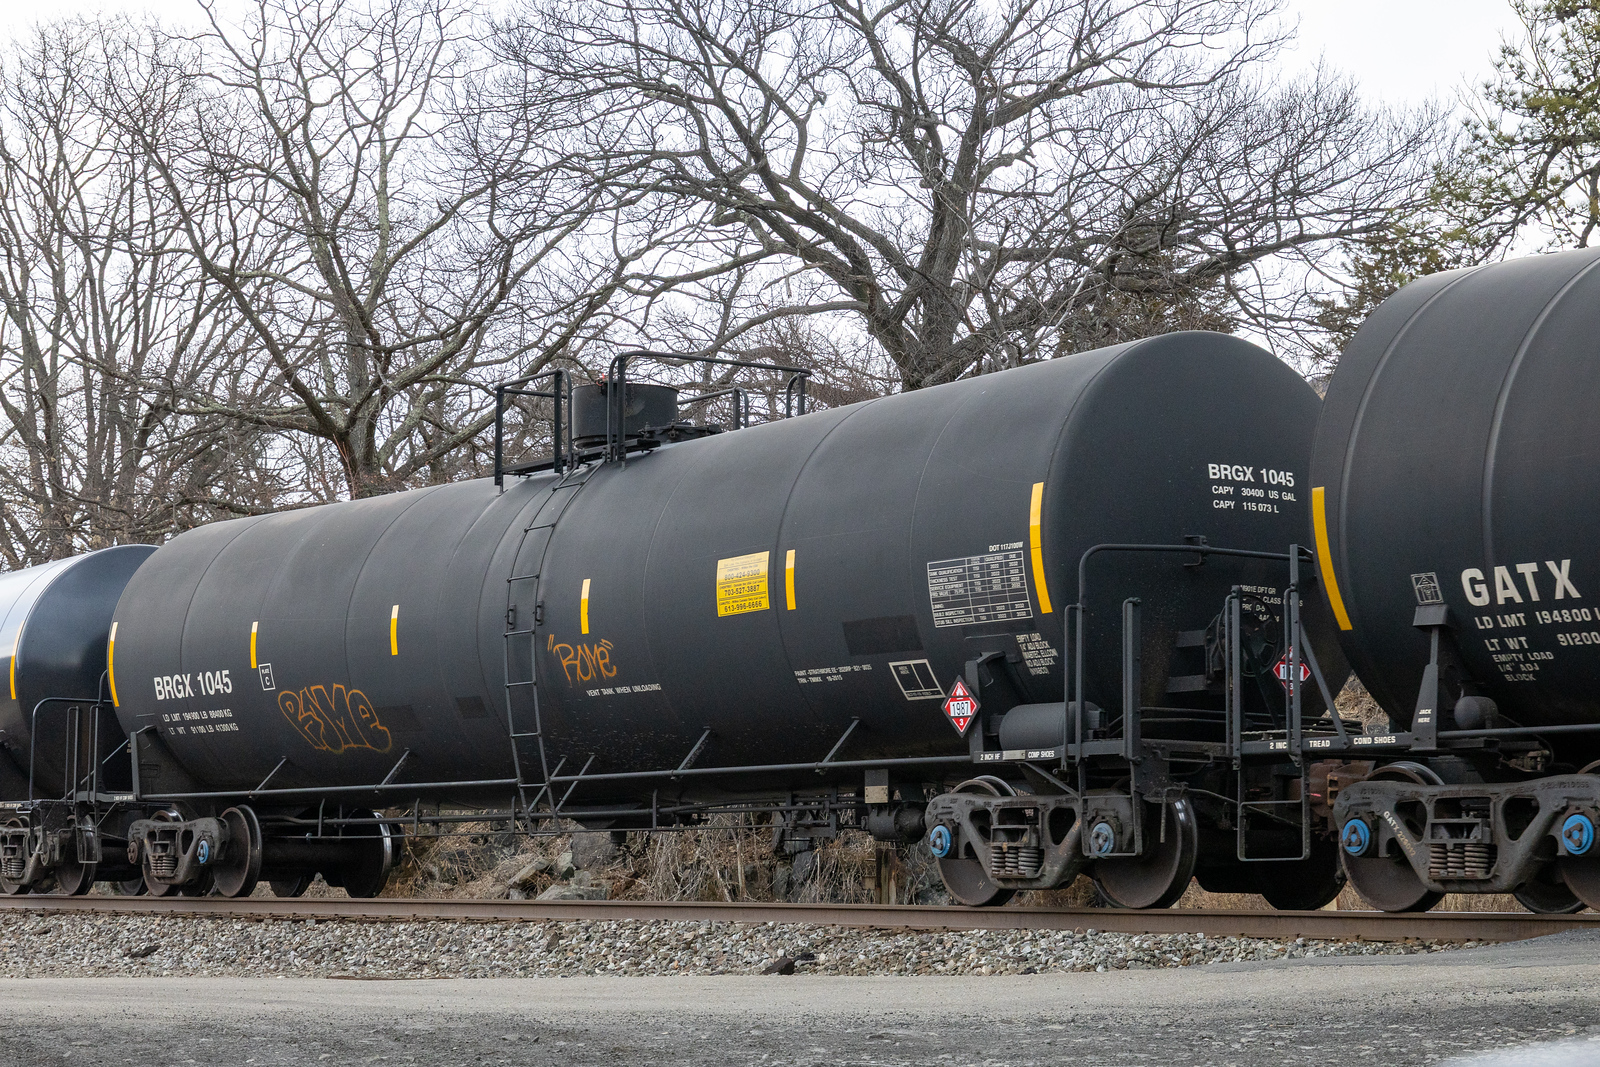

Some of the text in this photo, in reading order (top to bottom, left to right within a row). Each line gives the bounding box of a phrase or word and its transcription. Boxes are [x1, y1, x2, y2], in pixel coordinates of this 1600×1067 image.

[1208, 463, 1295, 487] BRGX 1045
[1212, 485, 1297, 502] CAPY 30400 US GAL
[1213, 500, 1235, 509] CAPY
[1274, 505, 1279, 513] L
[988, 544, 1000, 552] DOT
[724, 569, 760, 580] 800-424-9300
[1461, 558, 1582, 607] GATX
[725, 585, 760, 596] 703-527-3887
[724, 600, 762, 612] 613-996-6666
[1263, 596, 1281, 605] CLASS
[1475, 616, 1494, 630] LD
[1497, 612, 1527, 628] LMT
[1535, 608, 1592, 624] 194800
[1034, 641, 1050, 650] BLOCK
[1484, 631, 1600, 651] LT WT 91200
[1041, 657, 1055, 666] BLOCK
[1492, 651, 1555, 663] EMPTY LOAD
[1520, 662, 1540, 672] ADJ
[265, 676, 270, 686] C
[1504, 673, 1536, 682] BLOCK
[153, 669, 233, 700] BRGX 1045
[586, 689, 600, 697] VENT
[615, 686, 631, 694] WHEN
[631, 683, 661, 693] UNLOADING
[952, 701, 969, 716] 1987
[200, 710, 208, 719] LB
[959, 718, 964, 726] 3
[205, 724, 215, 733] LB
[1269, 735, 1396, 750] 2 INC TREAD COND SHOES
[1027, 750, 1055, 759] COMP SHOES
